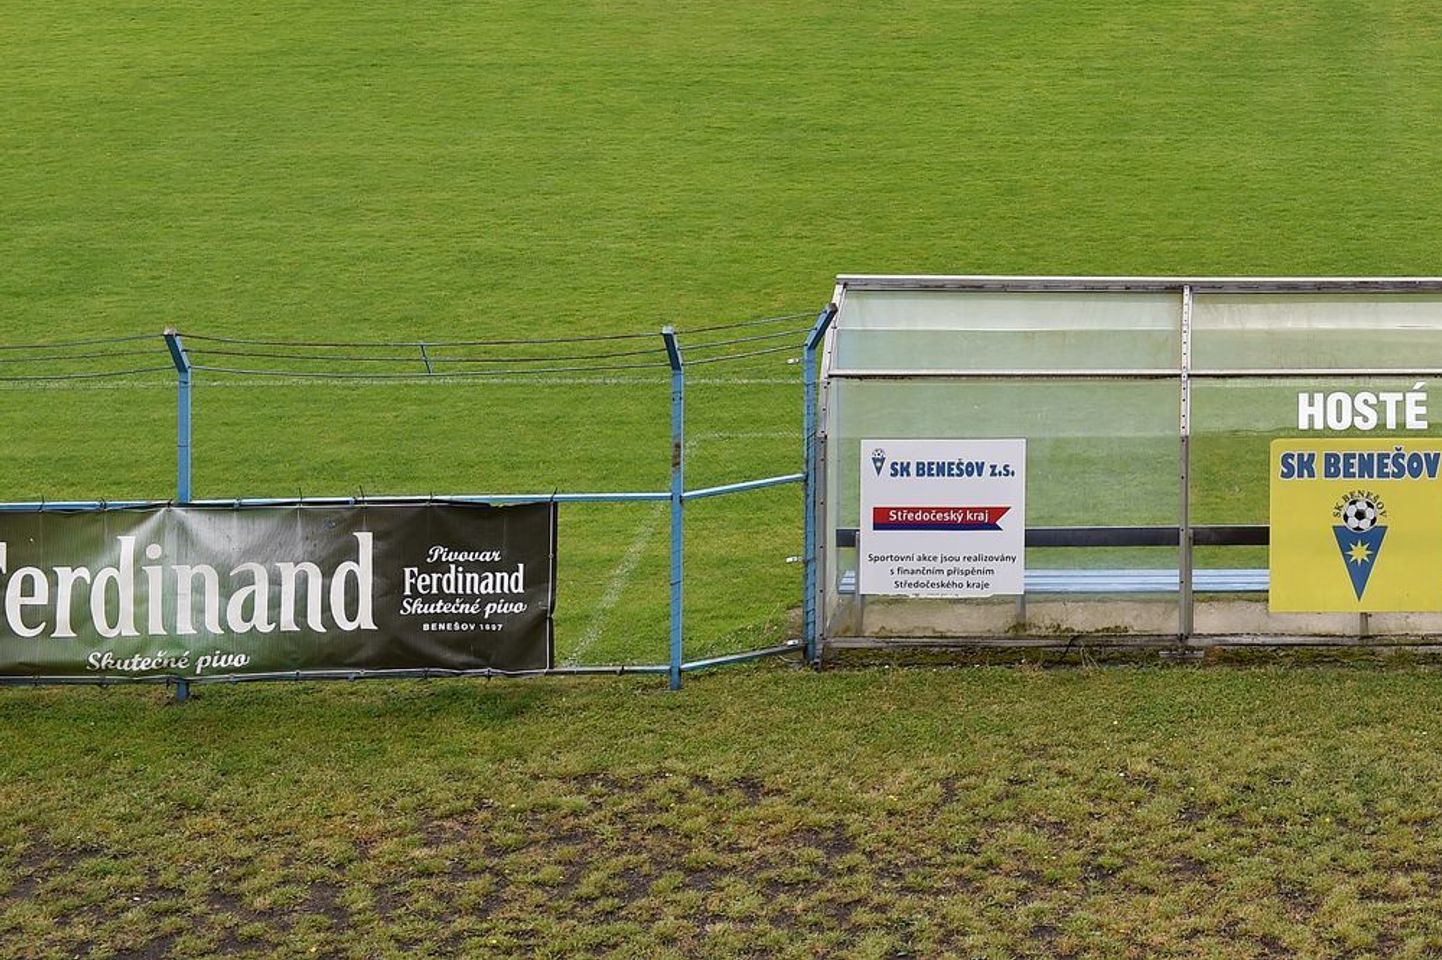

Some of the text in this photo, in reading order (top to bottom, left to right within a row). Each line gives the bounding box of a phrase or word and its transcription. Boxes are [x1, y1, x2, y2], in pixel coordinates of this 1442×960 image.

[1298, 382, 1428, 430] HOSTÉ
[890, 458, 1016, 478] SK BENEŠOV z.s.
[1280, 446, 1441, 479] SK BENEŠOV
[1333, 490, 1388, 518] SK BENEŠOV
[889, 510, 988, 524] Středočeský kraj
[426, 546, 501, 563] Pivovar
[868, 554, 1016, 564] Sportovní akce jsou realizovány
[403, 564, 525, 595] Ferdinand
[897, 567, 944, 576] finančním
[0, 532, 378, 638] erdinand
[894, 580, 990, 591] Středočeského kraje
[400, 598, 528, 619] Skutečné pivo
[423, 622, 476, 630] BENEŠOV
[86, 650, 250, 674] Skutečné pivo
